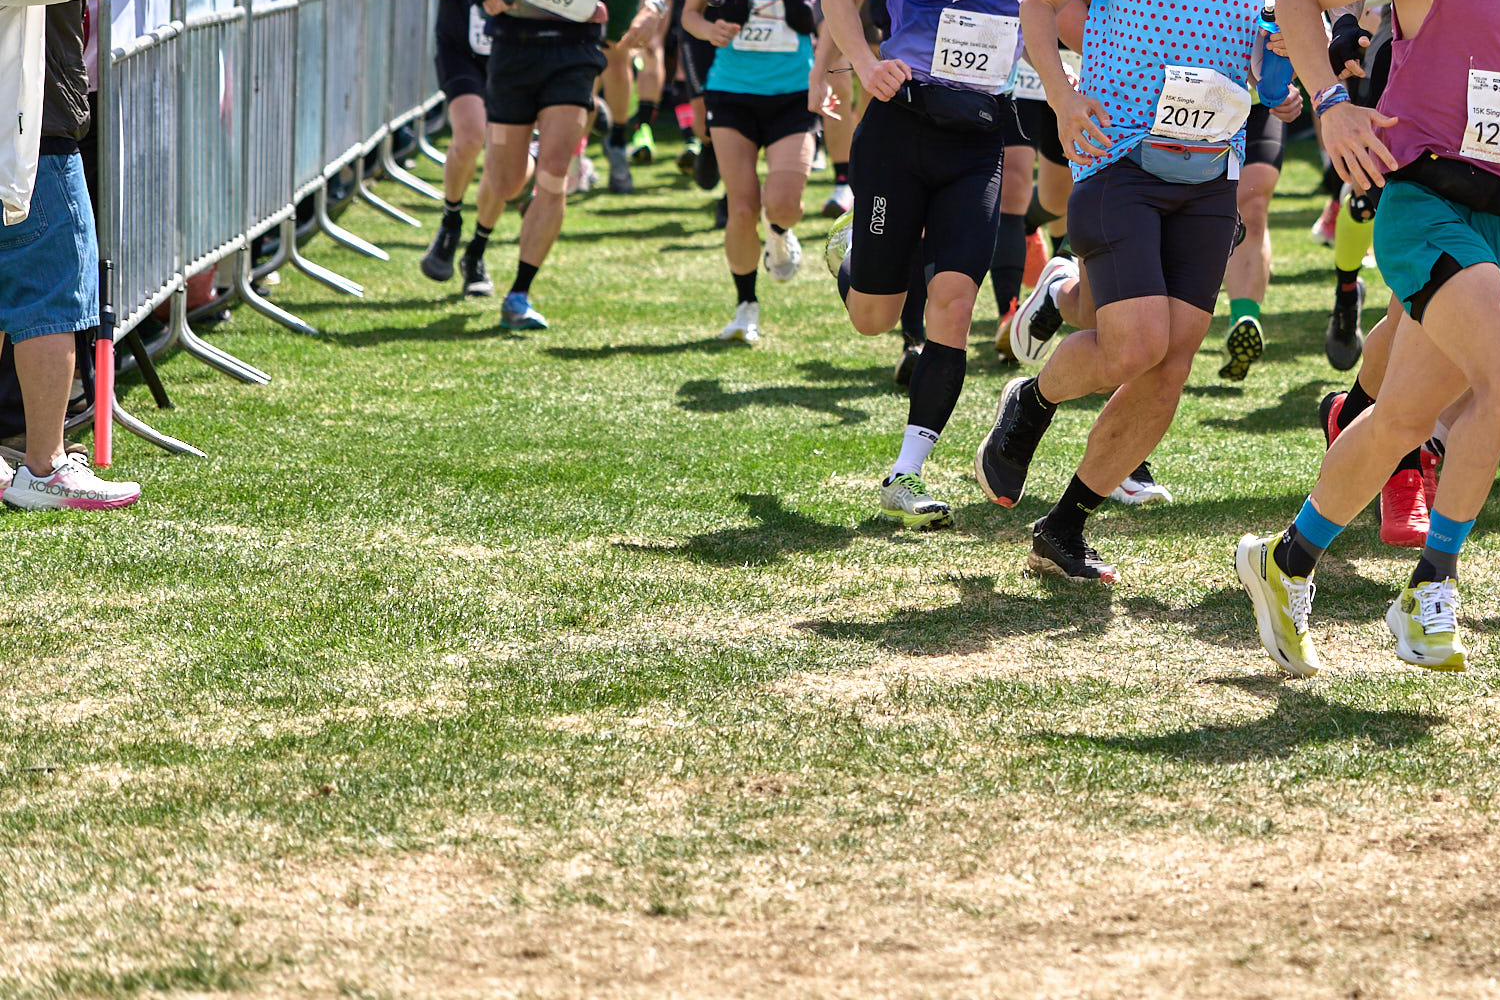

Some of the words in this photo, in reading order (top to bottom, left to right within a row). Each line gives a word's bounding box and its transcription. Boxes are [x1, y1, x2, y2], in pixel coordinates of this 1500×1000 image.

[940, 49, 989, 71] 1392
[1177, 96, 1195, 105] Single
[1161, 105, 1215, 129] 2017
[870, 196, 887, 235] 2XU
[28, 479, 70, 497] KOLON
[73, 488, 108, 500] SPORT
